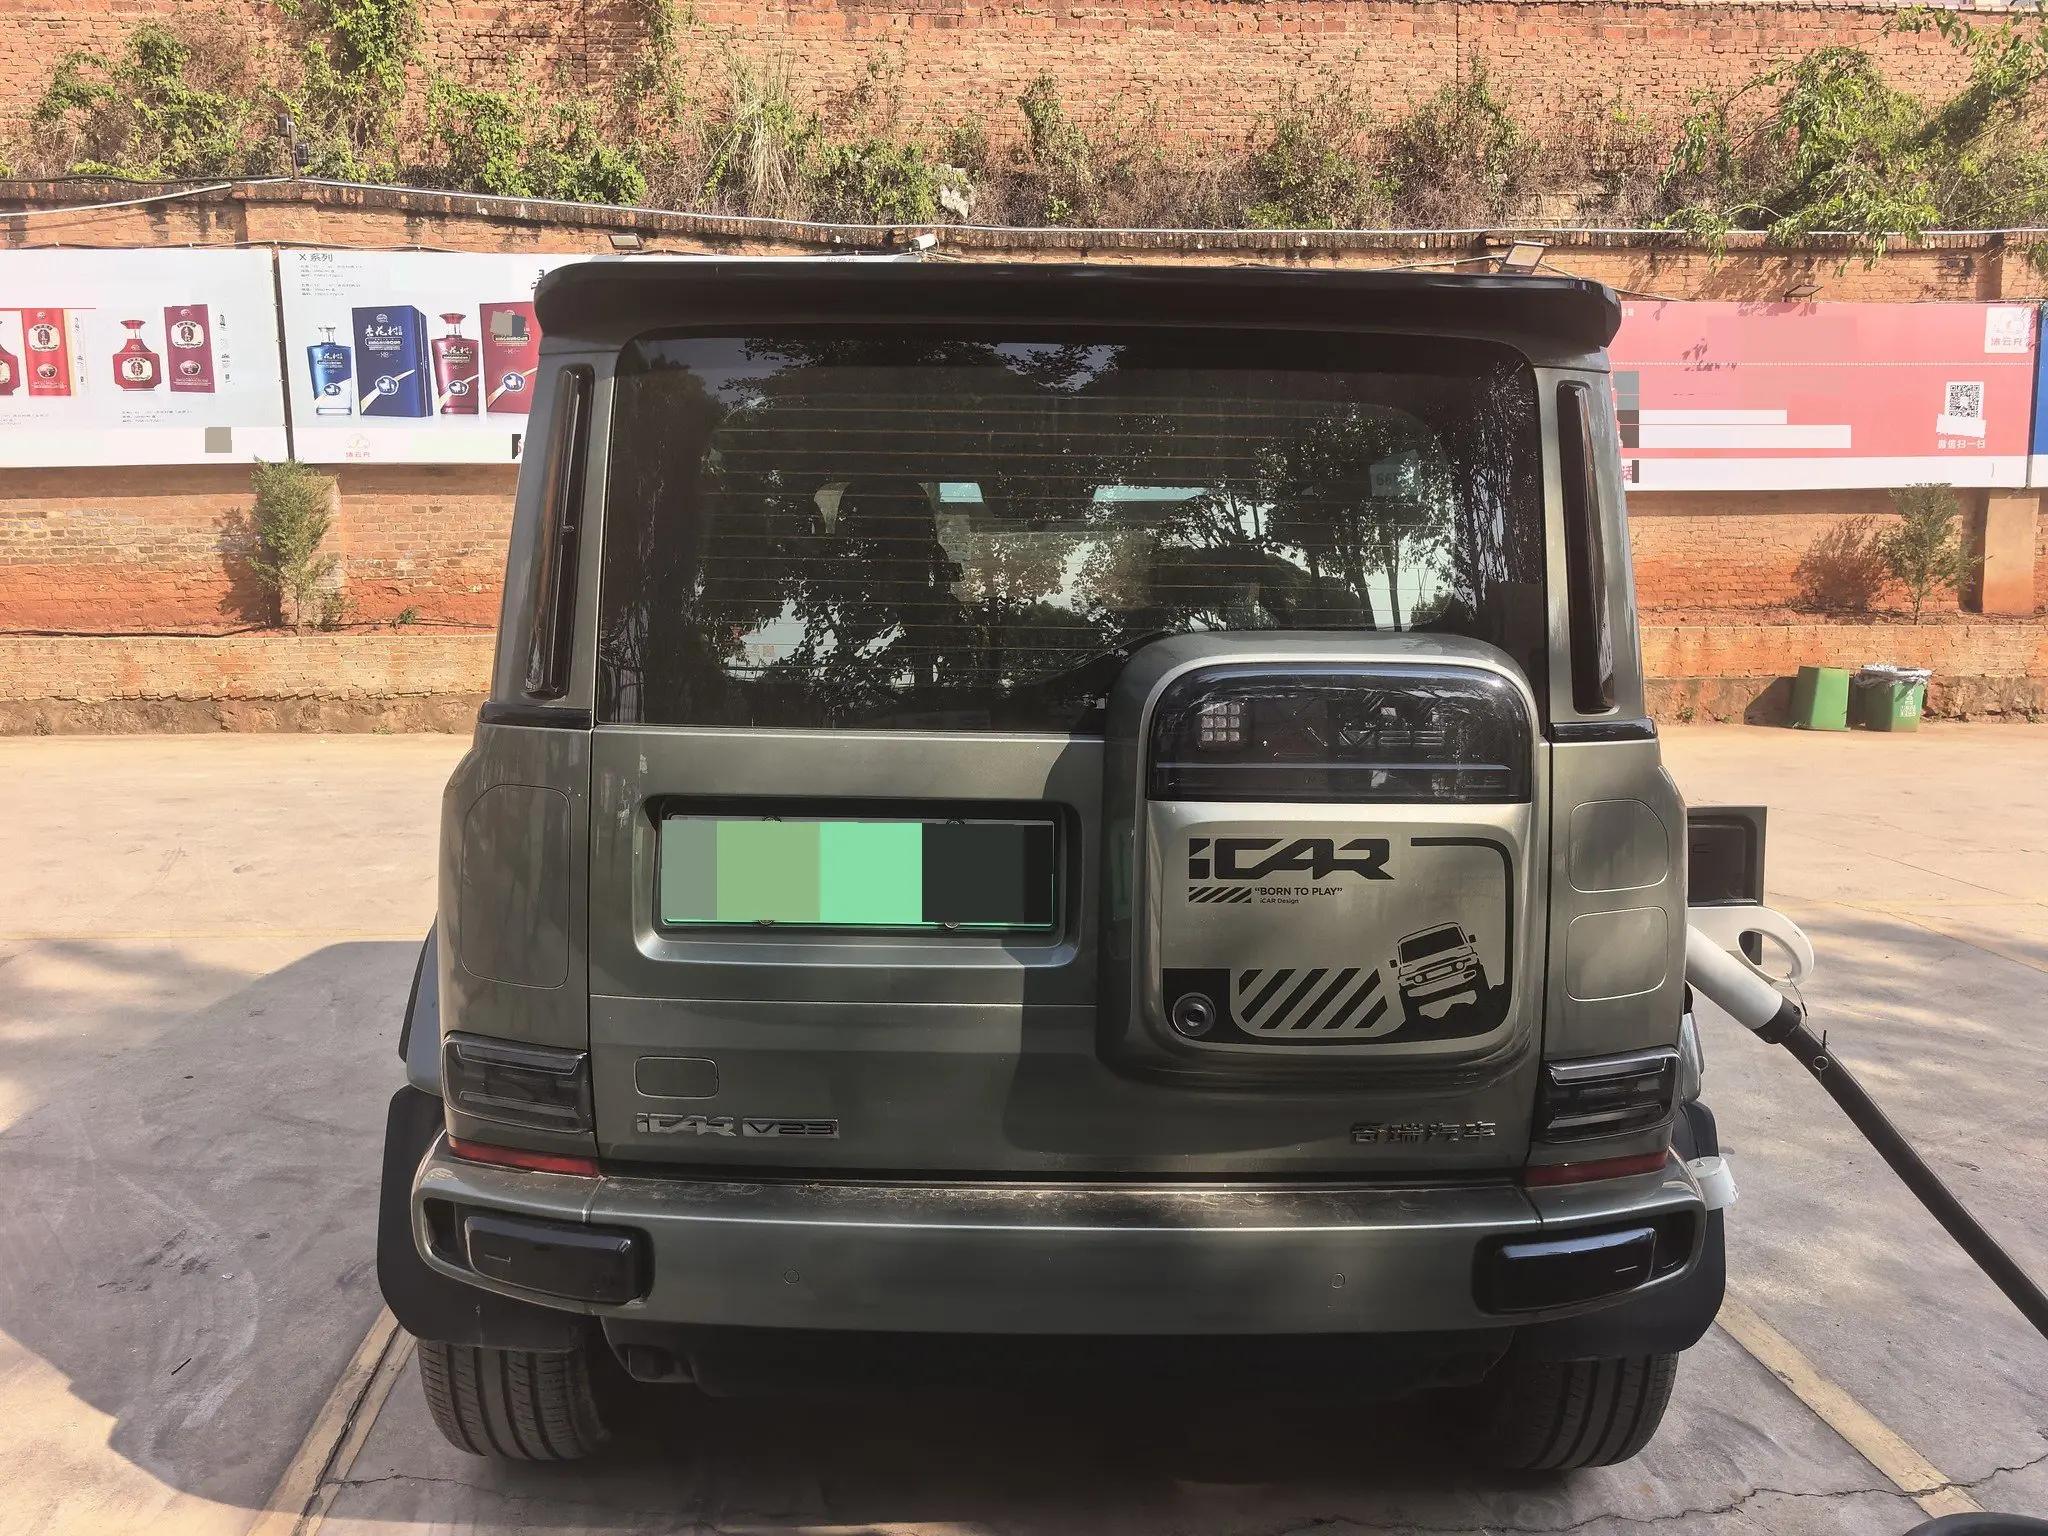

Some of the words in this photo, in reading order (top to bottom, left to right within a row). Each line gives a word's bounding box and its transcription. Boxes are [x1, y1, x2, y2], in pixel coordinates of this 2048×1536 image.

[311, 252, 334, 263] 系列
[1937, 439, 1986, 449] 微信扫一扫
[1189, 838, 1395, 880] iCAR
[1294, 886, 1309, 896] TO
[1278, 897, 1299, 905] Design
[637, 1112, 737, 1136] iCAR
[744, 1118, 838, 1137] V23
